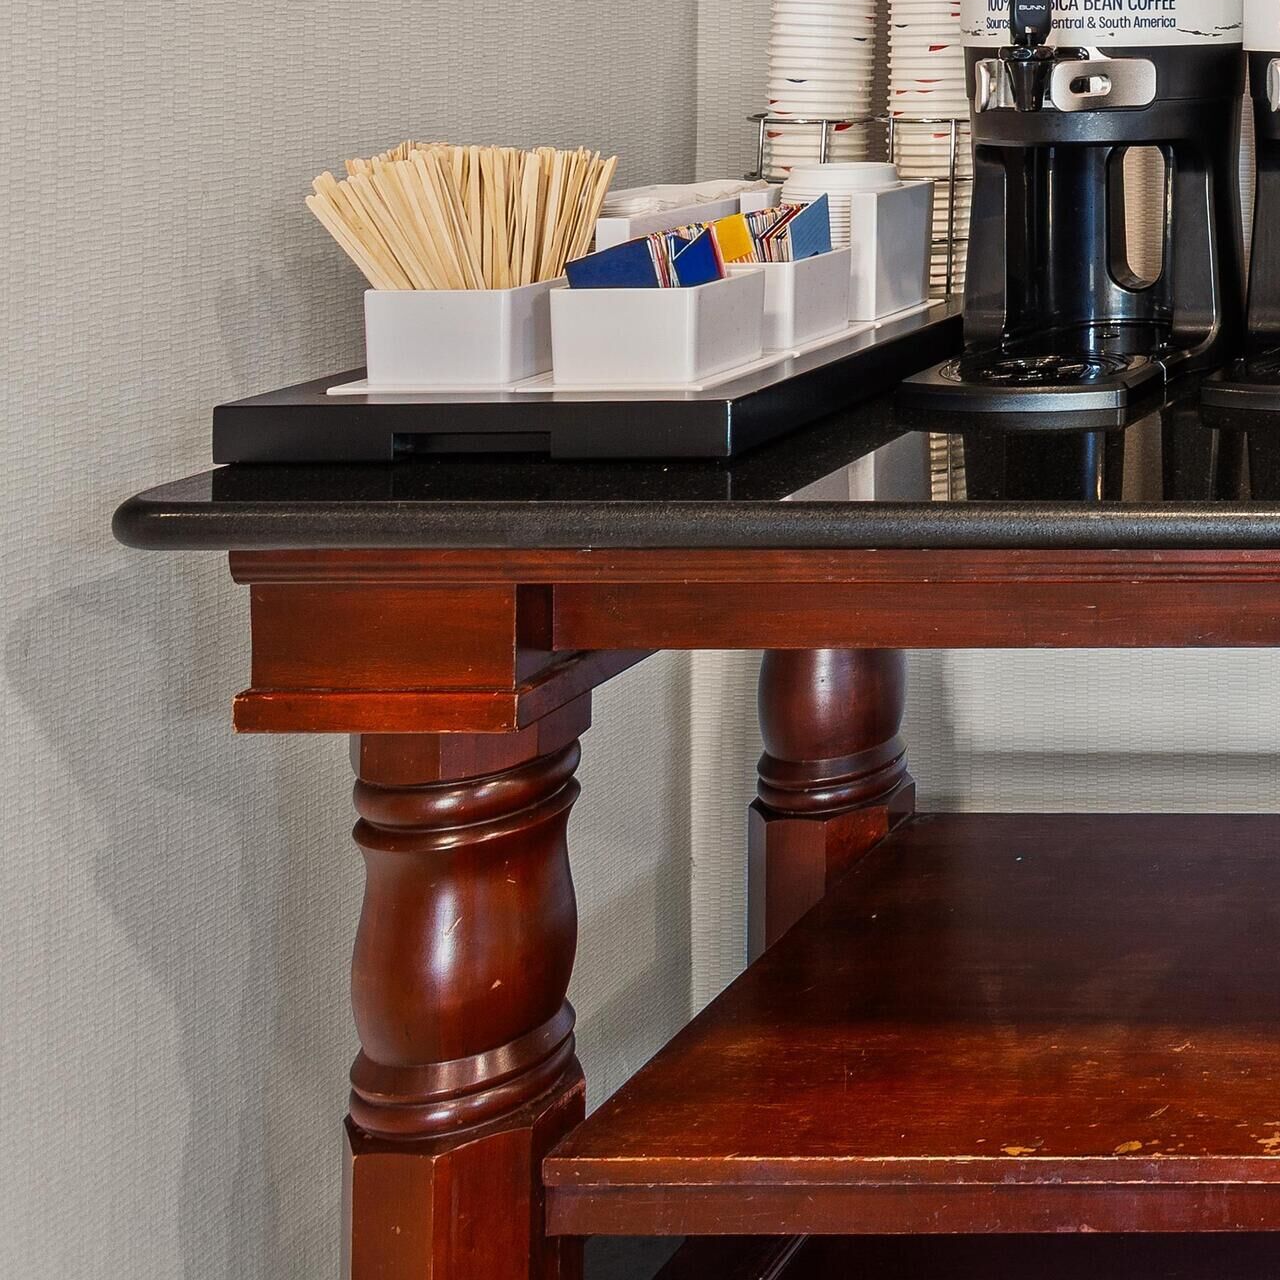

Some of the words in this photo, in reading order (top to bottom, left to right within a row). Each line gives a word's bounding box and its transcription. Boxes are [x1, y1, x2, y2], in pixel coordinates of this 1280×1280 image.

[986, 17, 1011, 29] Source
[1052, 16, 1084, 29] entral
[1087, 17, 1096, 28] &
[1099, 16, 1131, 29] South
[1133, 15, 1176, 29] America
